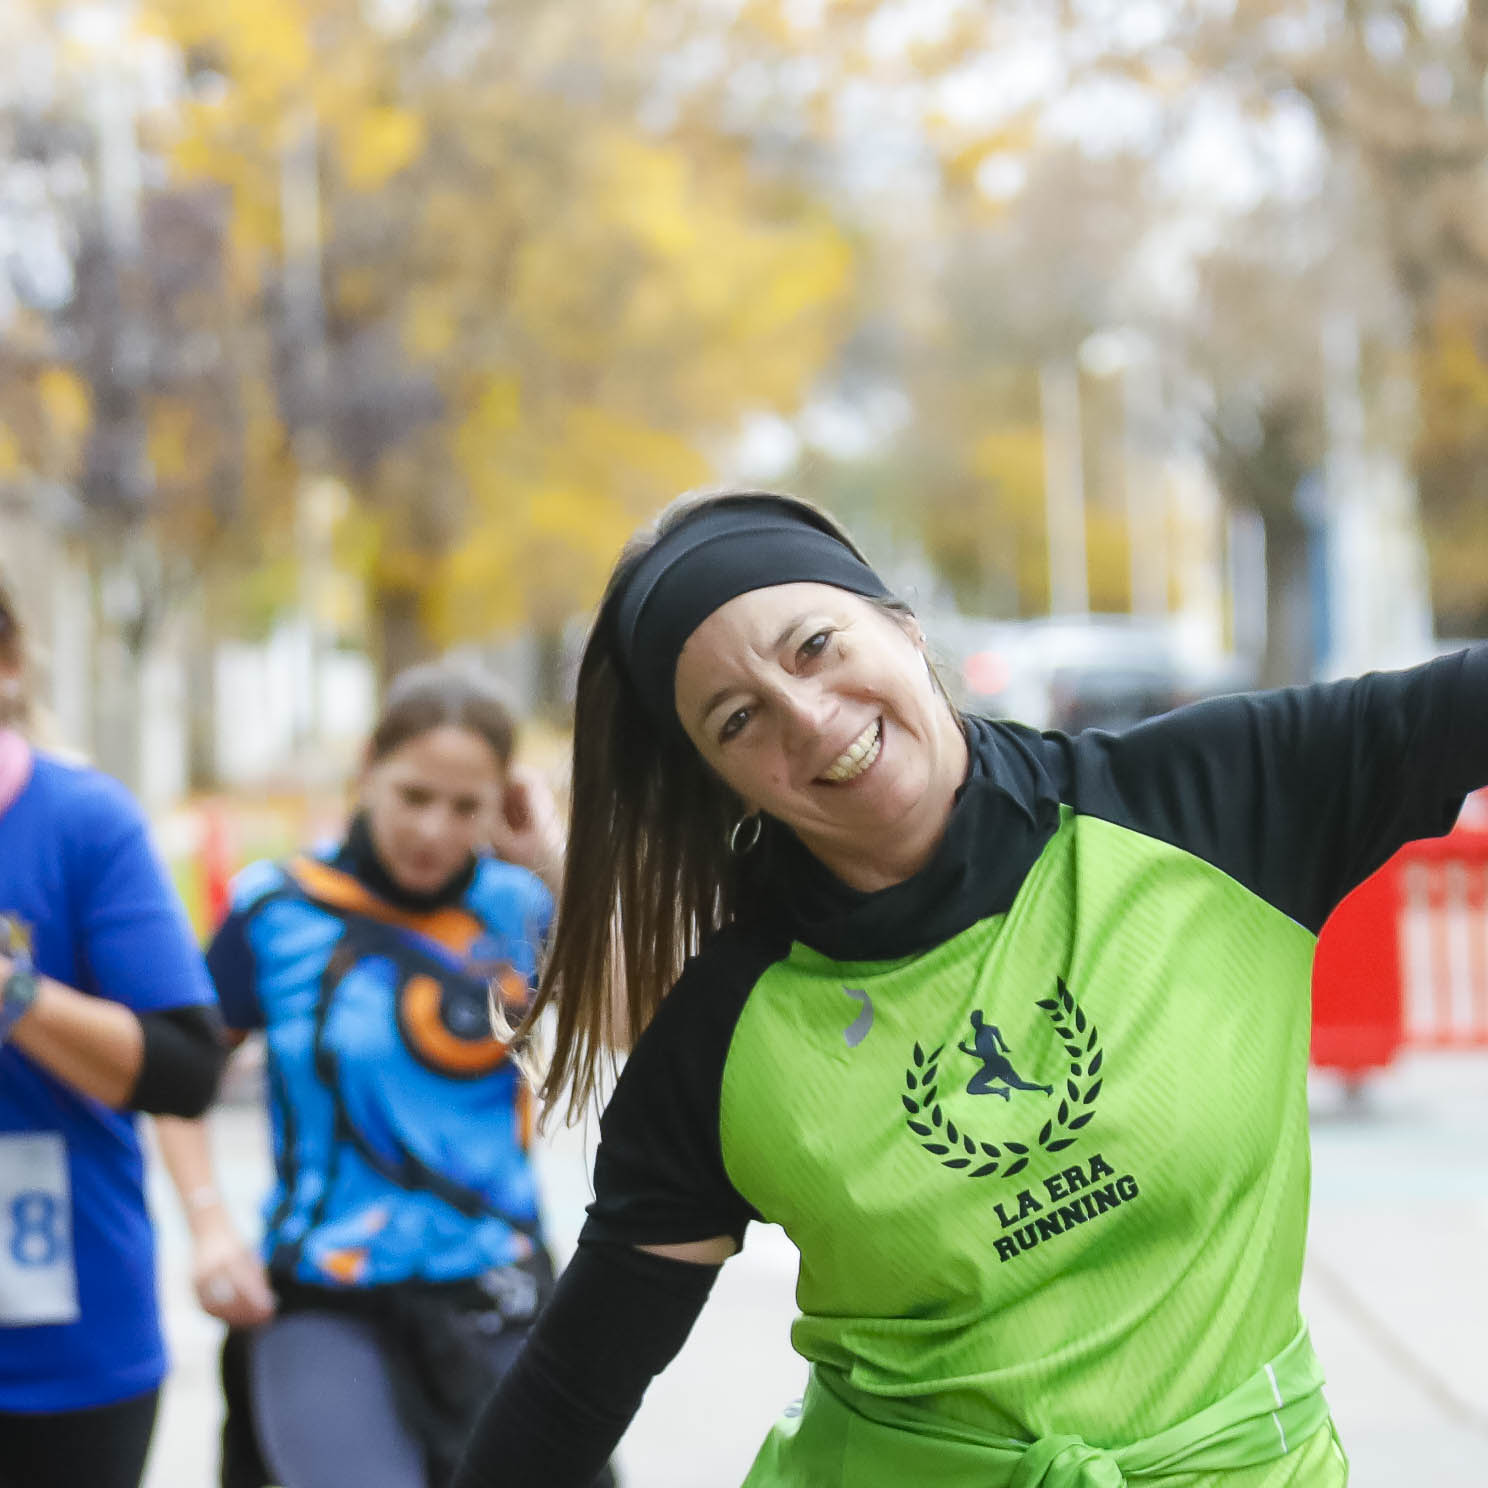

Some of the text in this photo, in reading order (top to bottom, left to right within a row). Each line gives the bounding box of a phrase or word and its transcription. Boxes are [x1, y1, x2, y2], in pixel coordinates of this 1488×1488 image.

[992, 1153, 1116, 1229] LA ERA
[992, 1174, 1140, 1263] RUNNING
